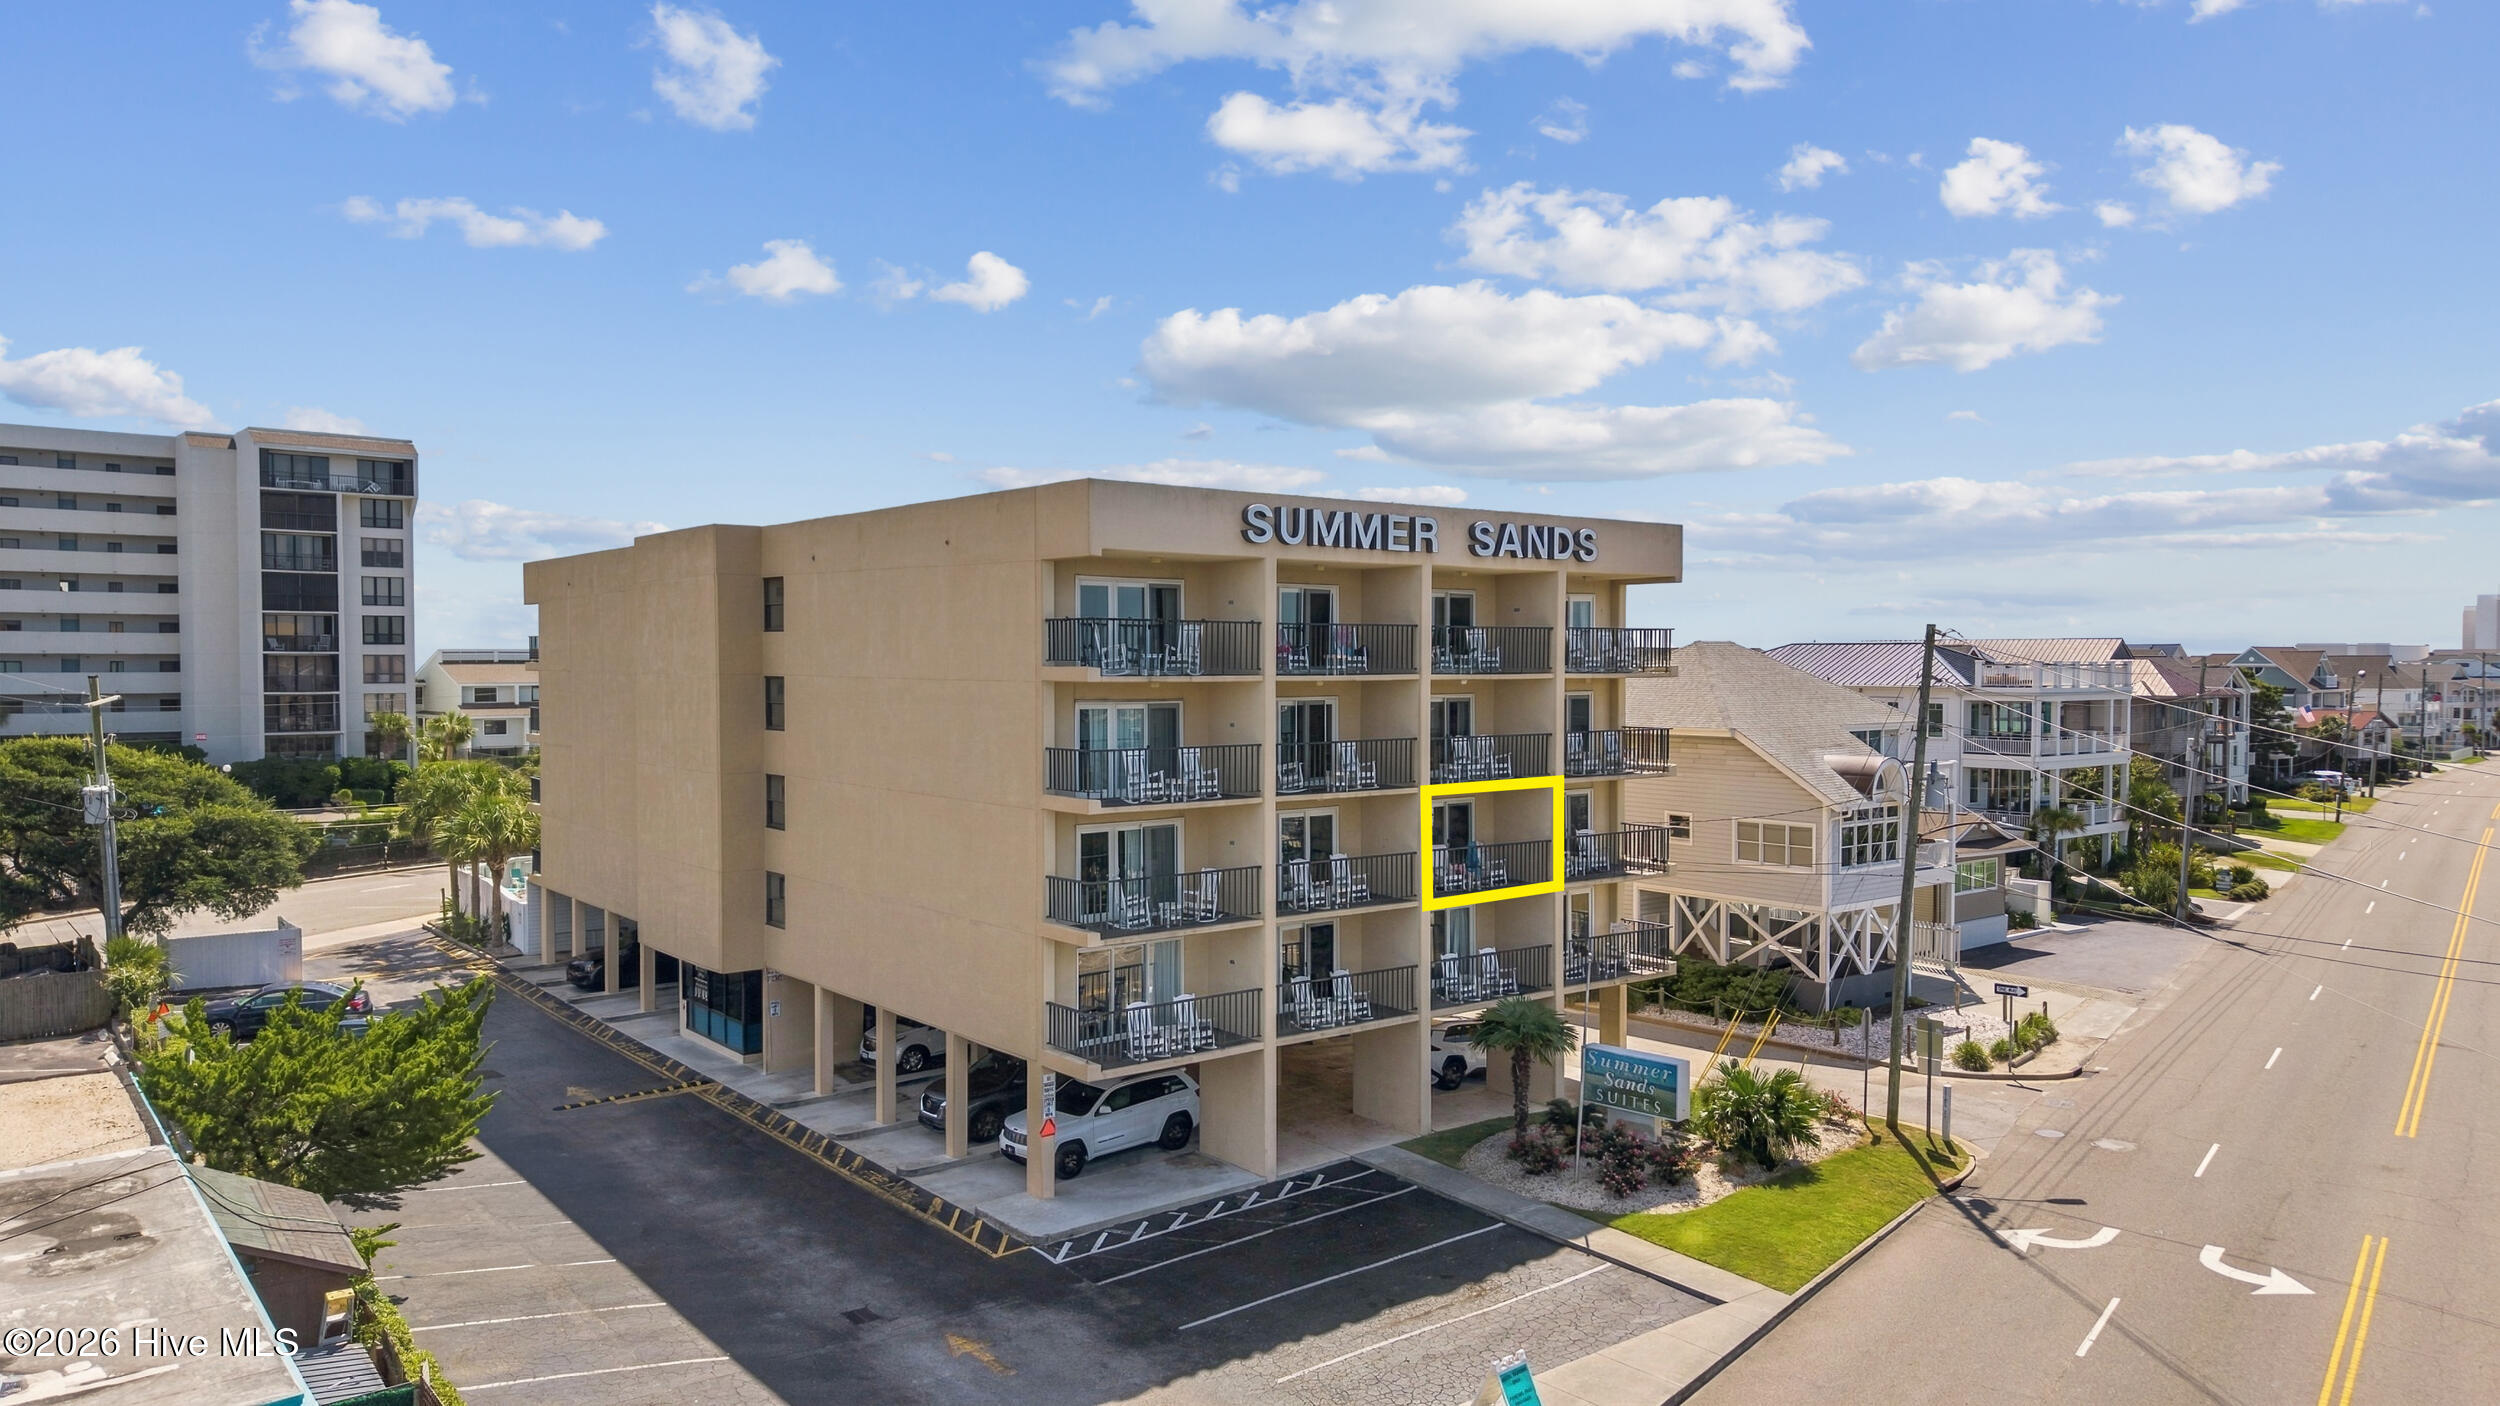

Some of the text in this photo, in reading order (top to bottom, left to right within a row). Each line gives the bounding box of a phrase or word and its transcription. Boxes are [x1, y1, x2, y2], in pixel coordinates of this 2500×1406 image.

[1241, 503, 1599, 563] SUMMER SANDS
[1586, 1050, 1673, 1080] Summer
[1604, 1071, 1656, 1095] Sands
[1596, 1088, 1661, 1114] SUITES
